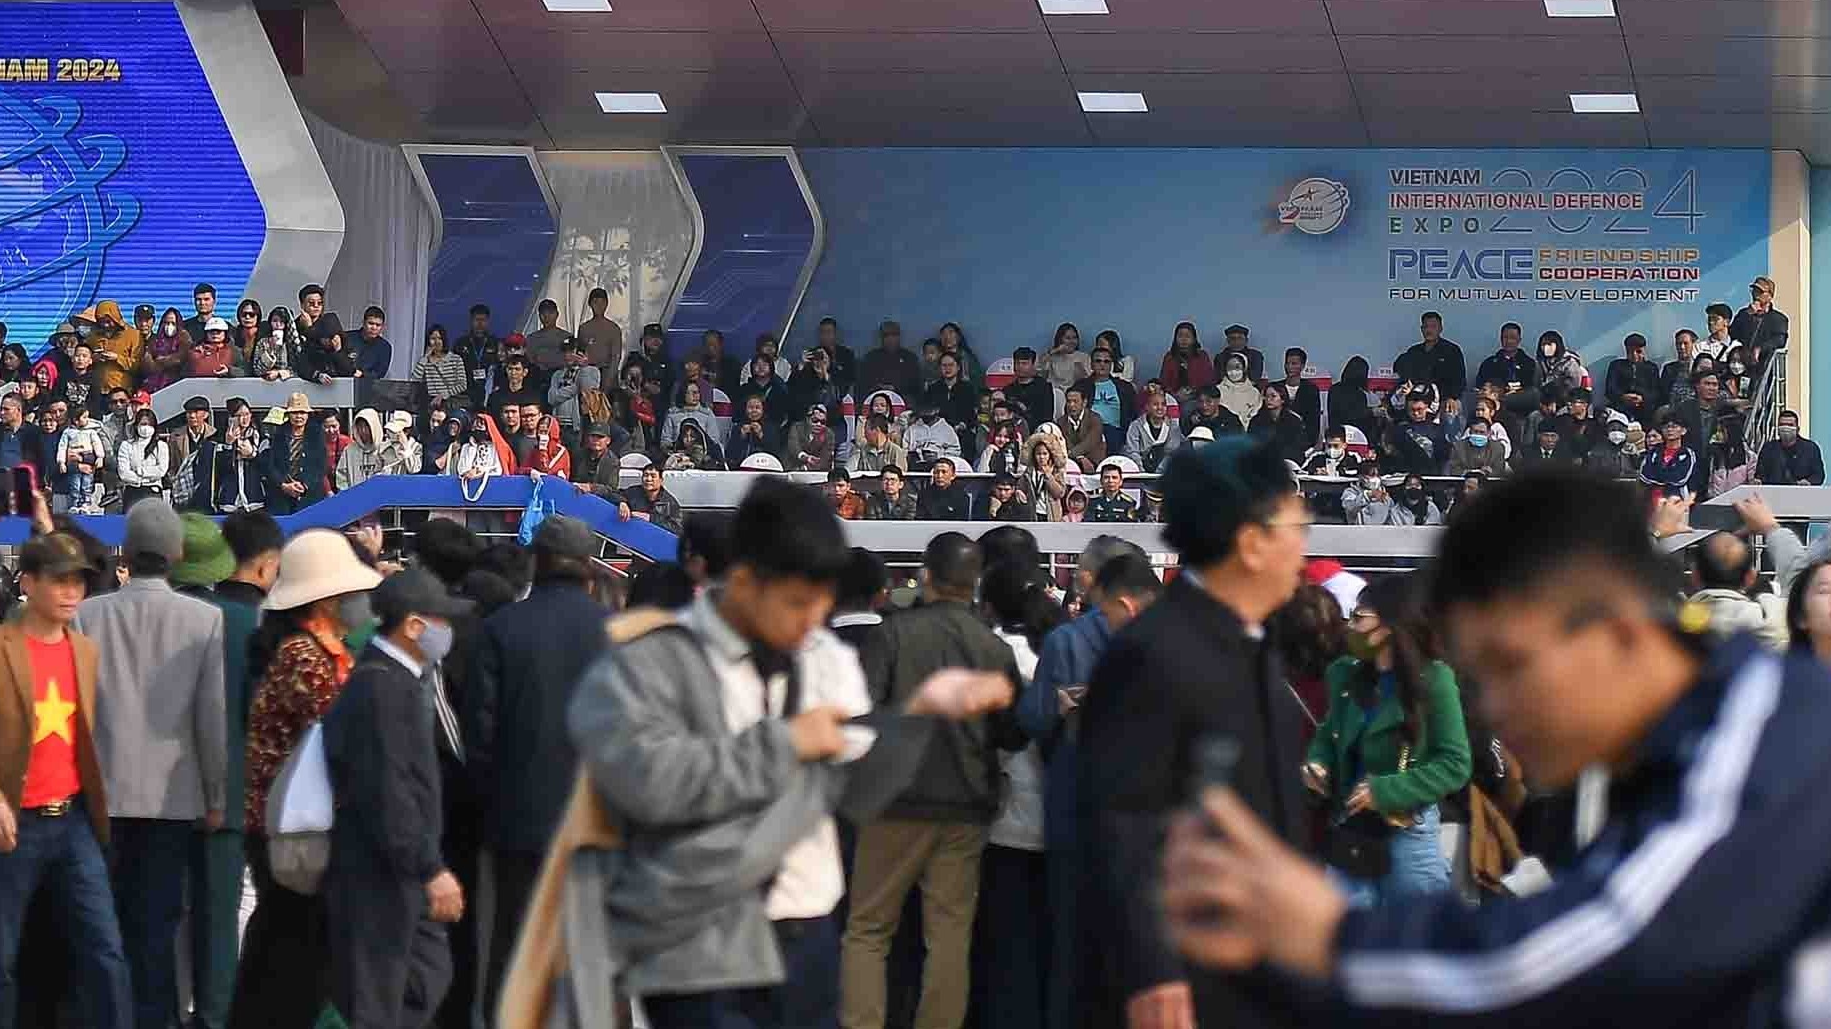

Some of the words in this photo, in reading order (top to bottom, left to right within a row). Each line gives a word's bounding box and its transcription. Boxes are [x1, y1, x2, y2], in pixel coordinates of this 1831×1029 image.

[57, 58, 122, 82] 2024
[1389, 169, 1481, 185] VIETNAM
[1389, 192, 1548, 209] INTERNATIONAL
[1553, 192, 1644, 209] DEFENCE
[1389, 217, 1480, 233] EXPO
[1538, 249, 1699, 263] FRIENDSHIP
[1388, 249, 1534, 280] PEACE
[1538, 267, 1699, 280] COOPERATION
[1389, 288, 1432, 300] FOR
[1438, 288, 1528, 300] MUTUAL
[1535, 288, 1699, 301] DEVELOPMENT
